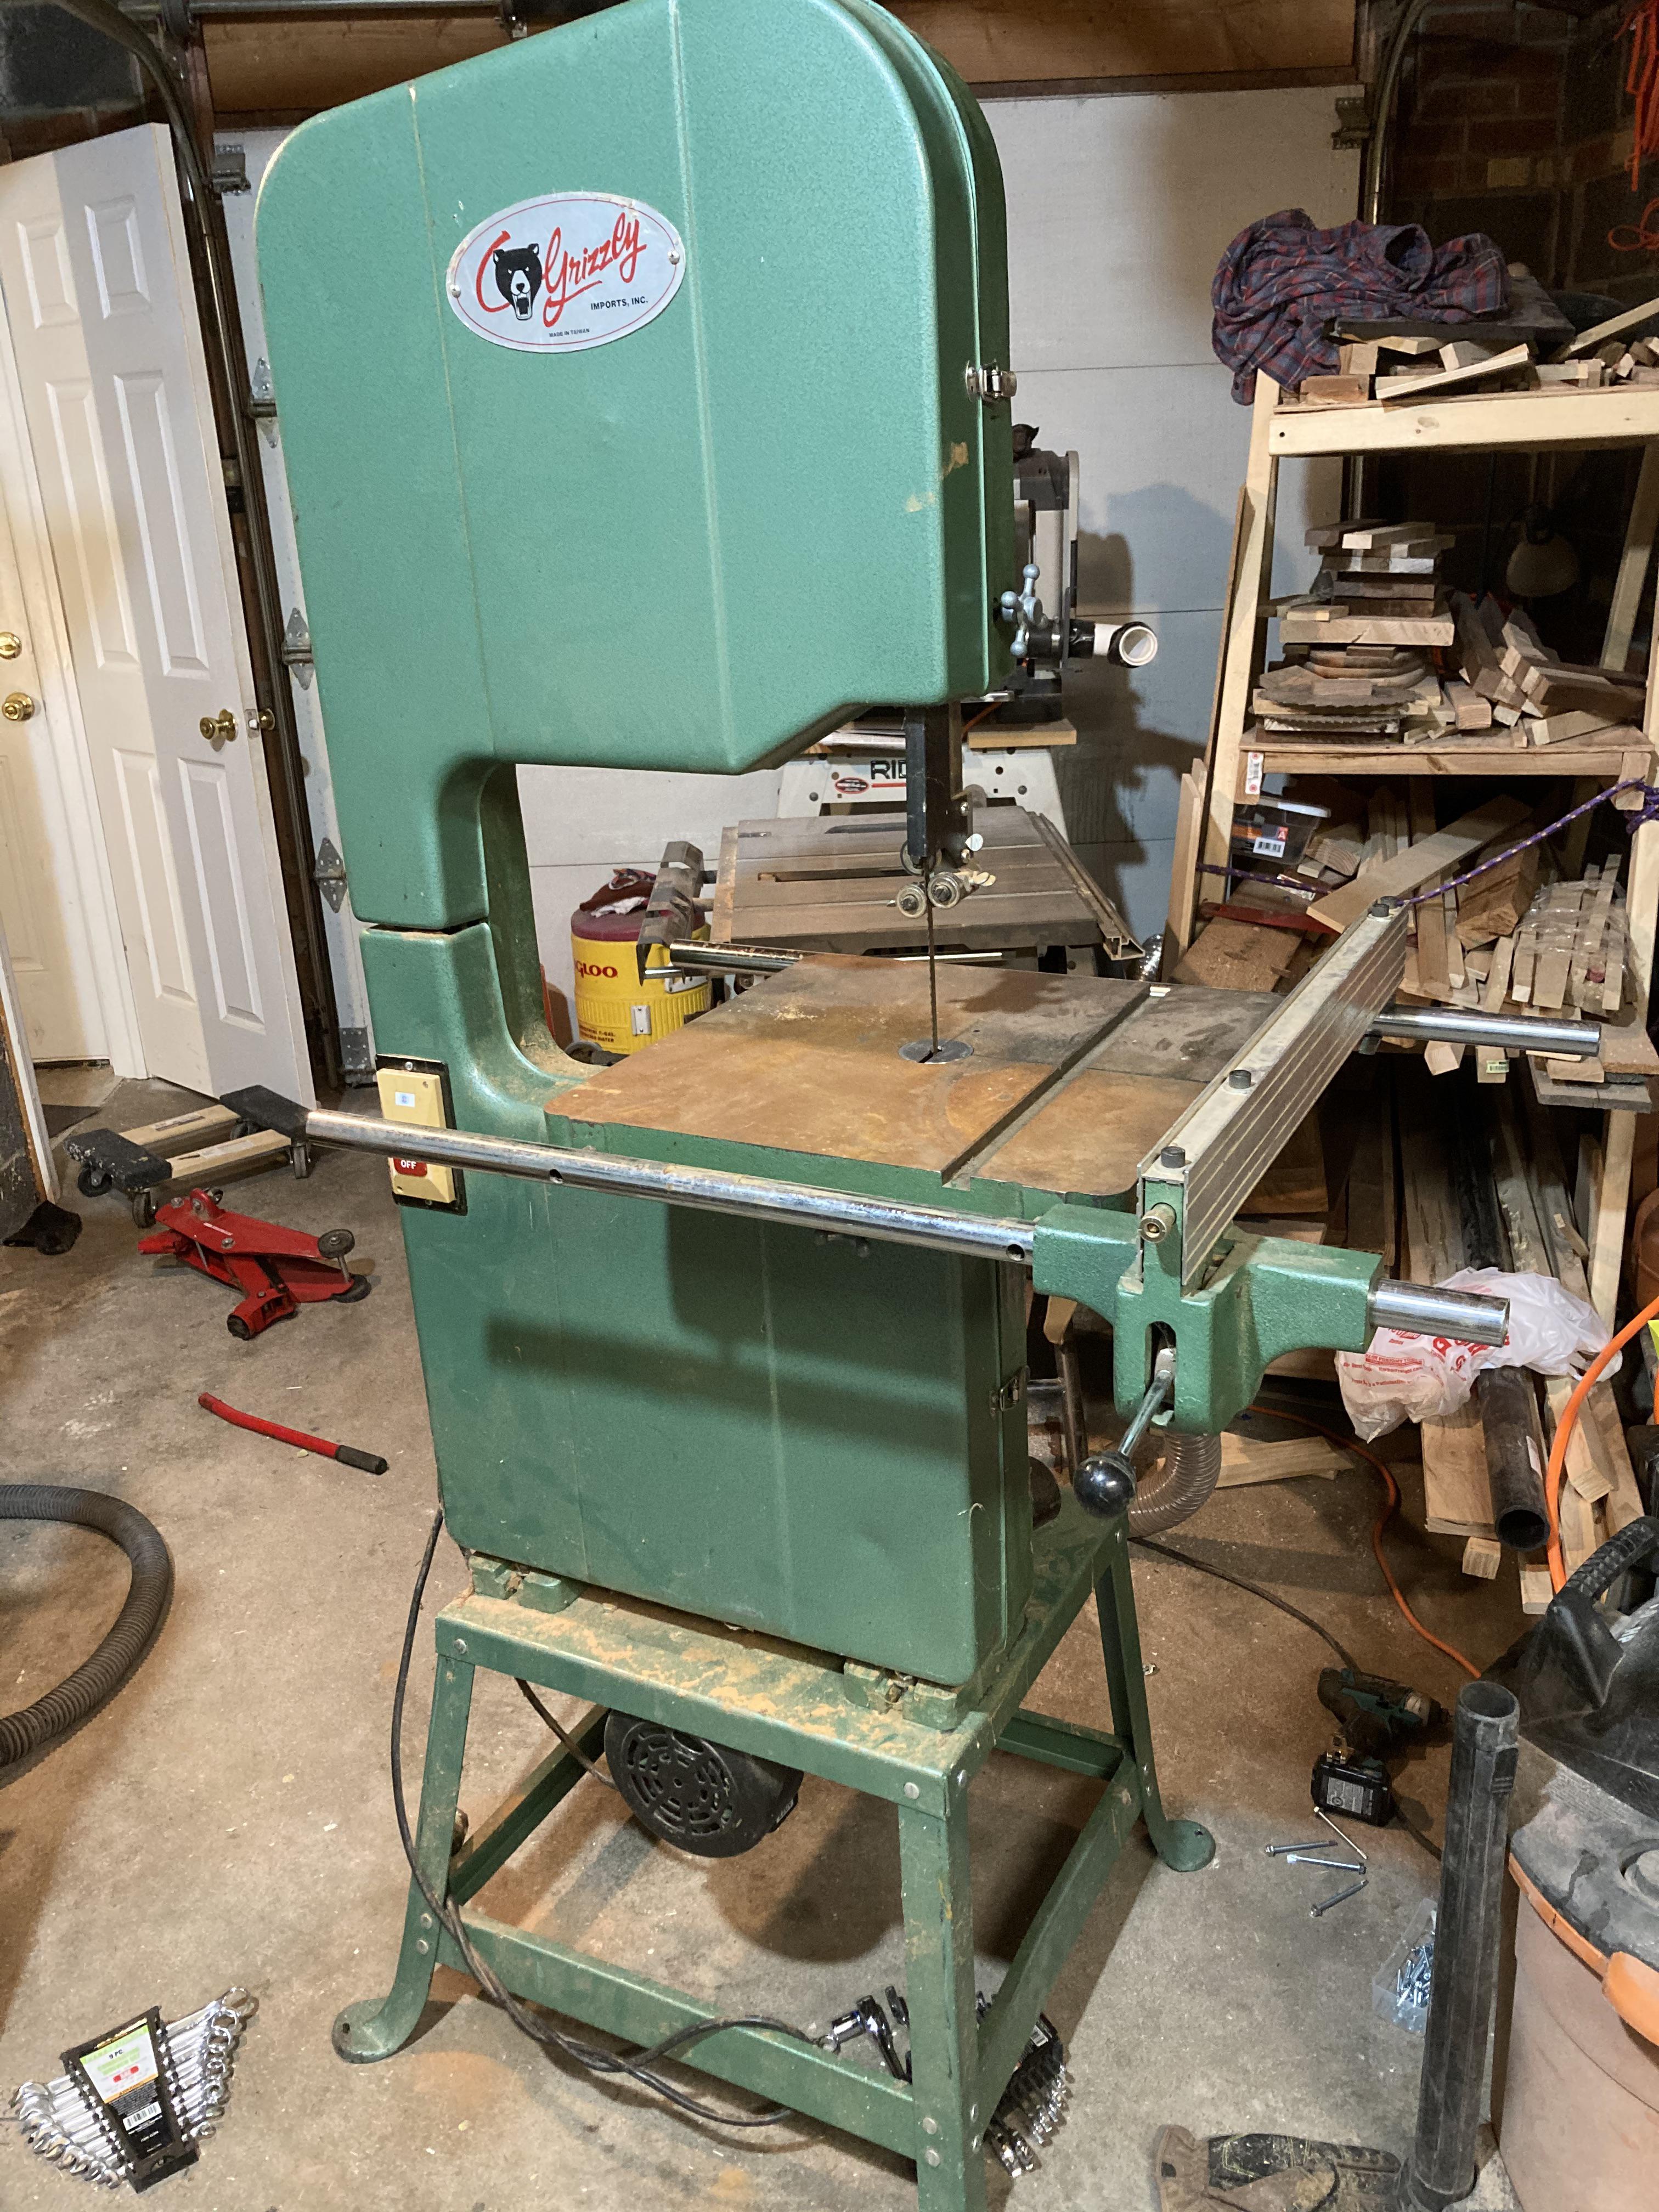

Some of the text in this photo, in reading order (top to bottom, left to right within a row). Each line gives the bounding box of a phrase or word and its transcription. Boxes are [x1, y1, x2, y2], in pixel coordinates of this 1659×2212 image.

[541, 212, 647, 328] Grizzly
[590, 296, 648, 311] IMPORTS, INC.
[400, 1159, 416, 1170] OFF
